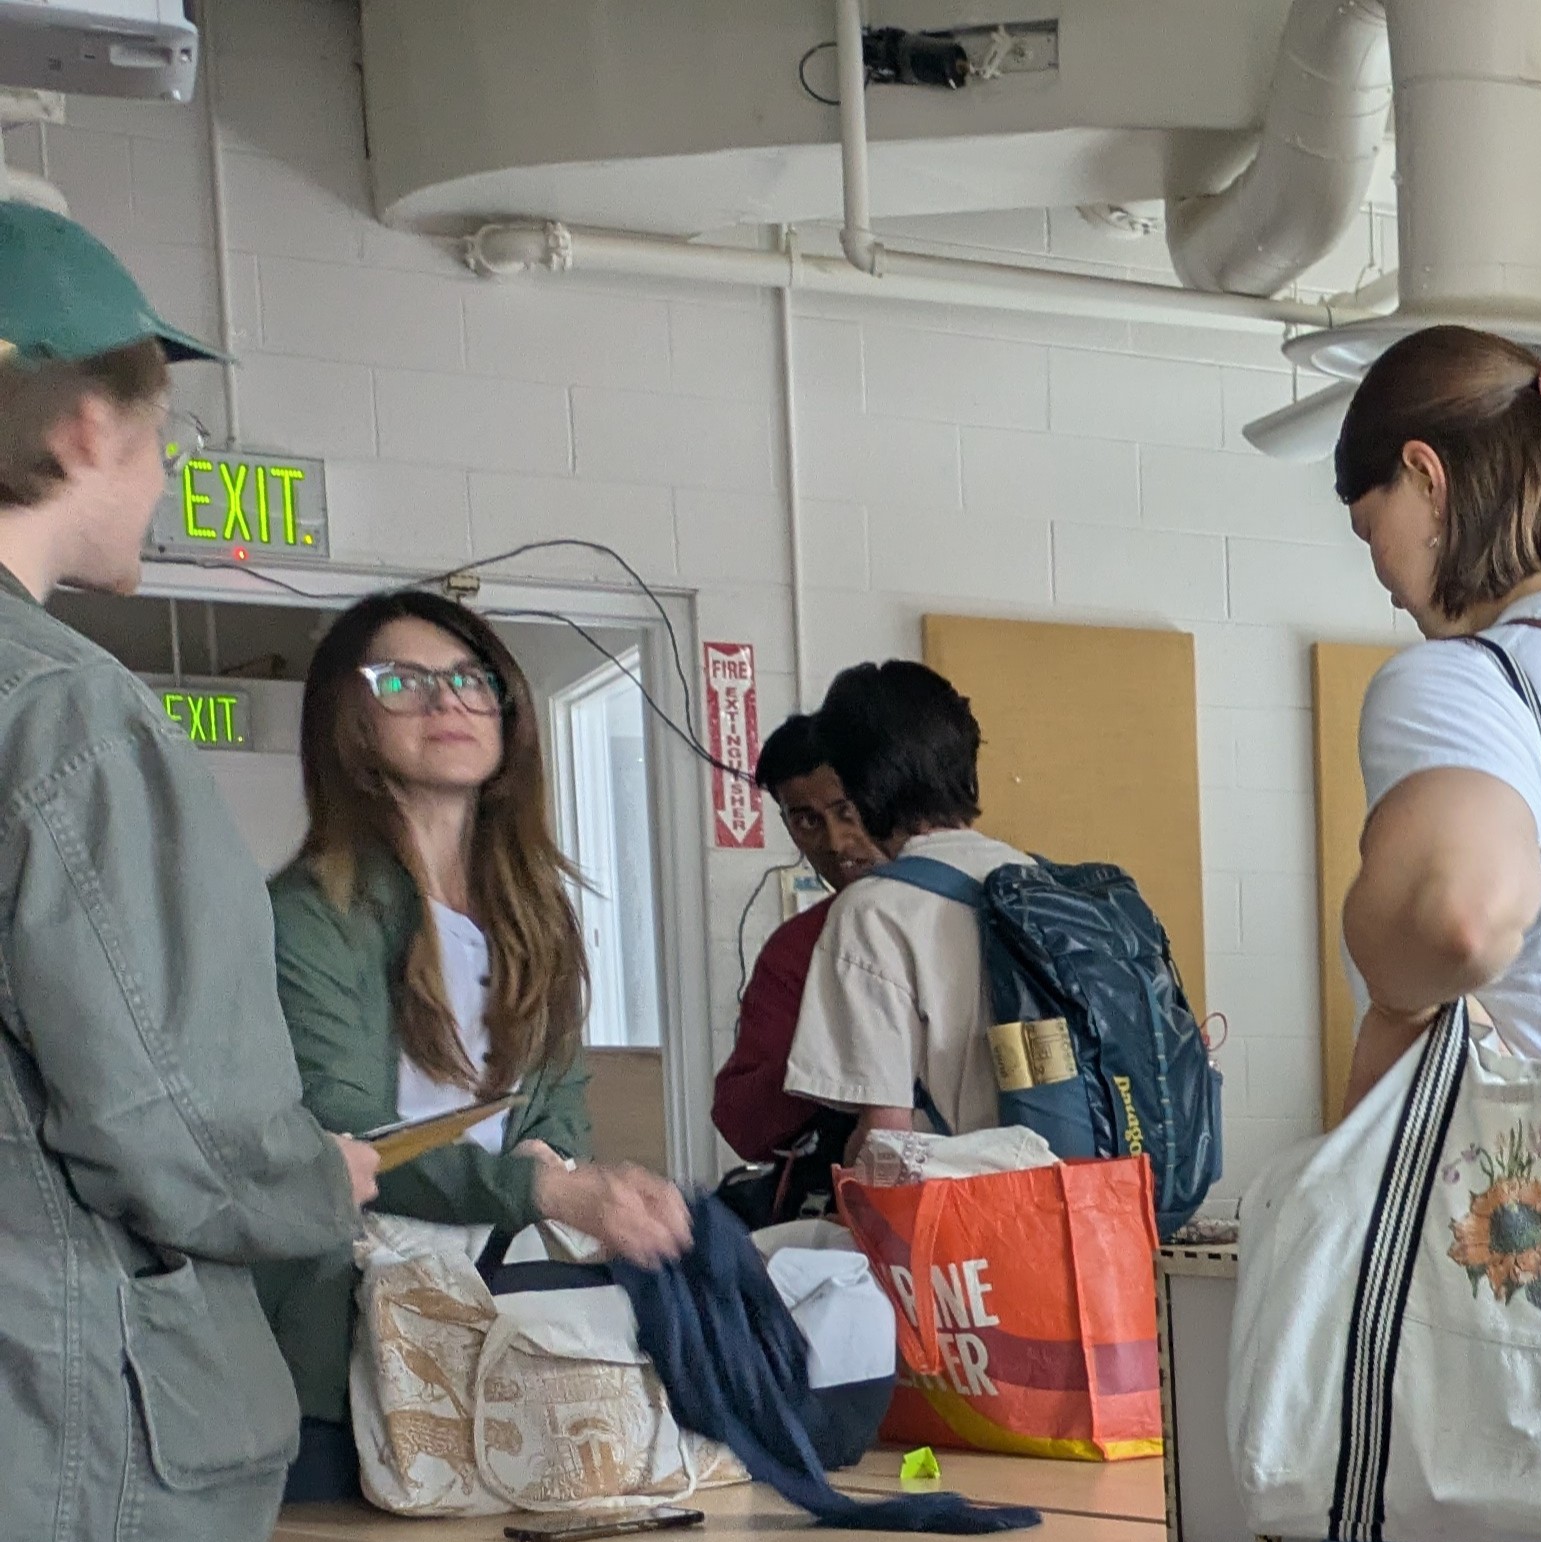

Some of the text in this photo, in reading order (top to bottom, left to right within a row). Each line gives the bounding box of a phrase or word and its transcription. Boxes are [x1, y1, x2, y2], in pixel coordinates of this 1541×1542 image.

[183, 459, 305, 545] EXIT
[712, 659, 748, 680] FIRE
[164, 693, 238, 742] EXIT
[1113, 1075, 1143, 1157] patago
